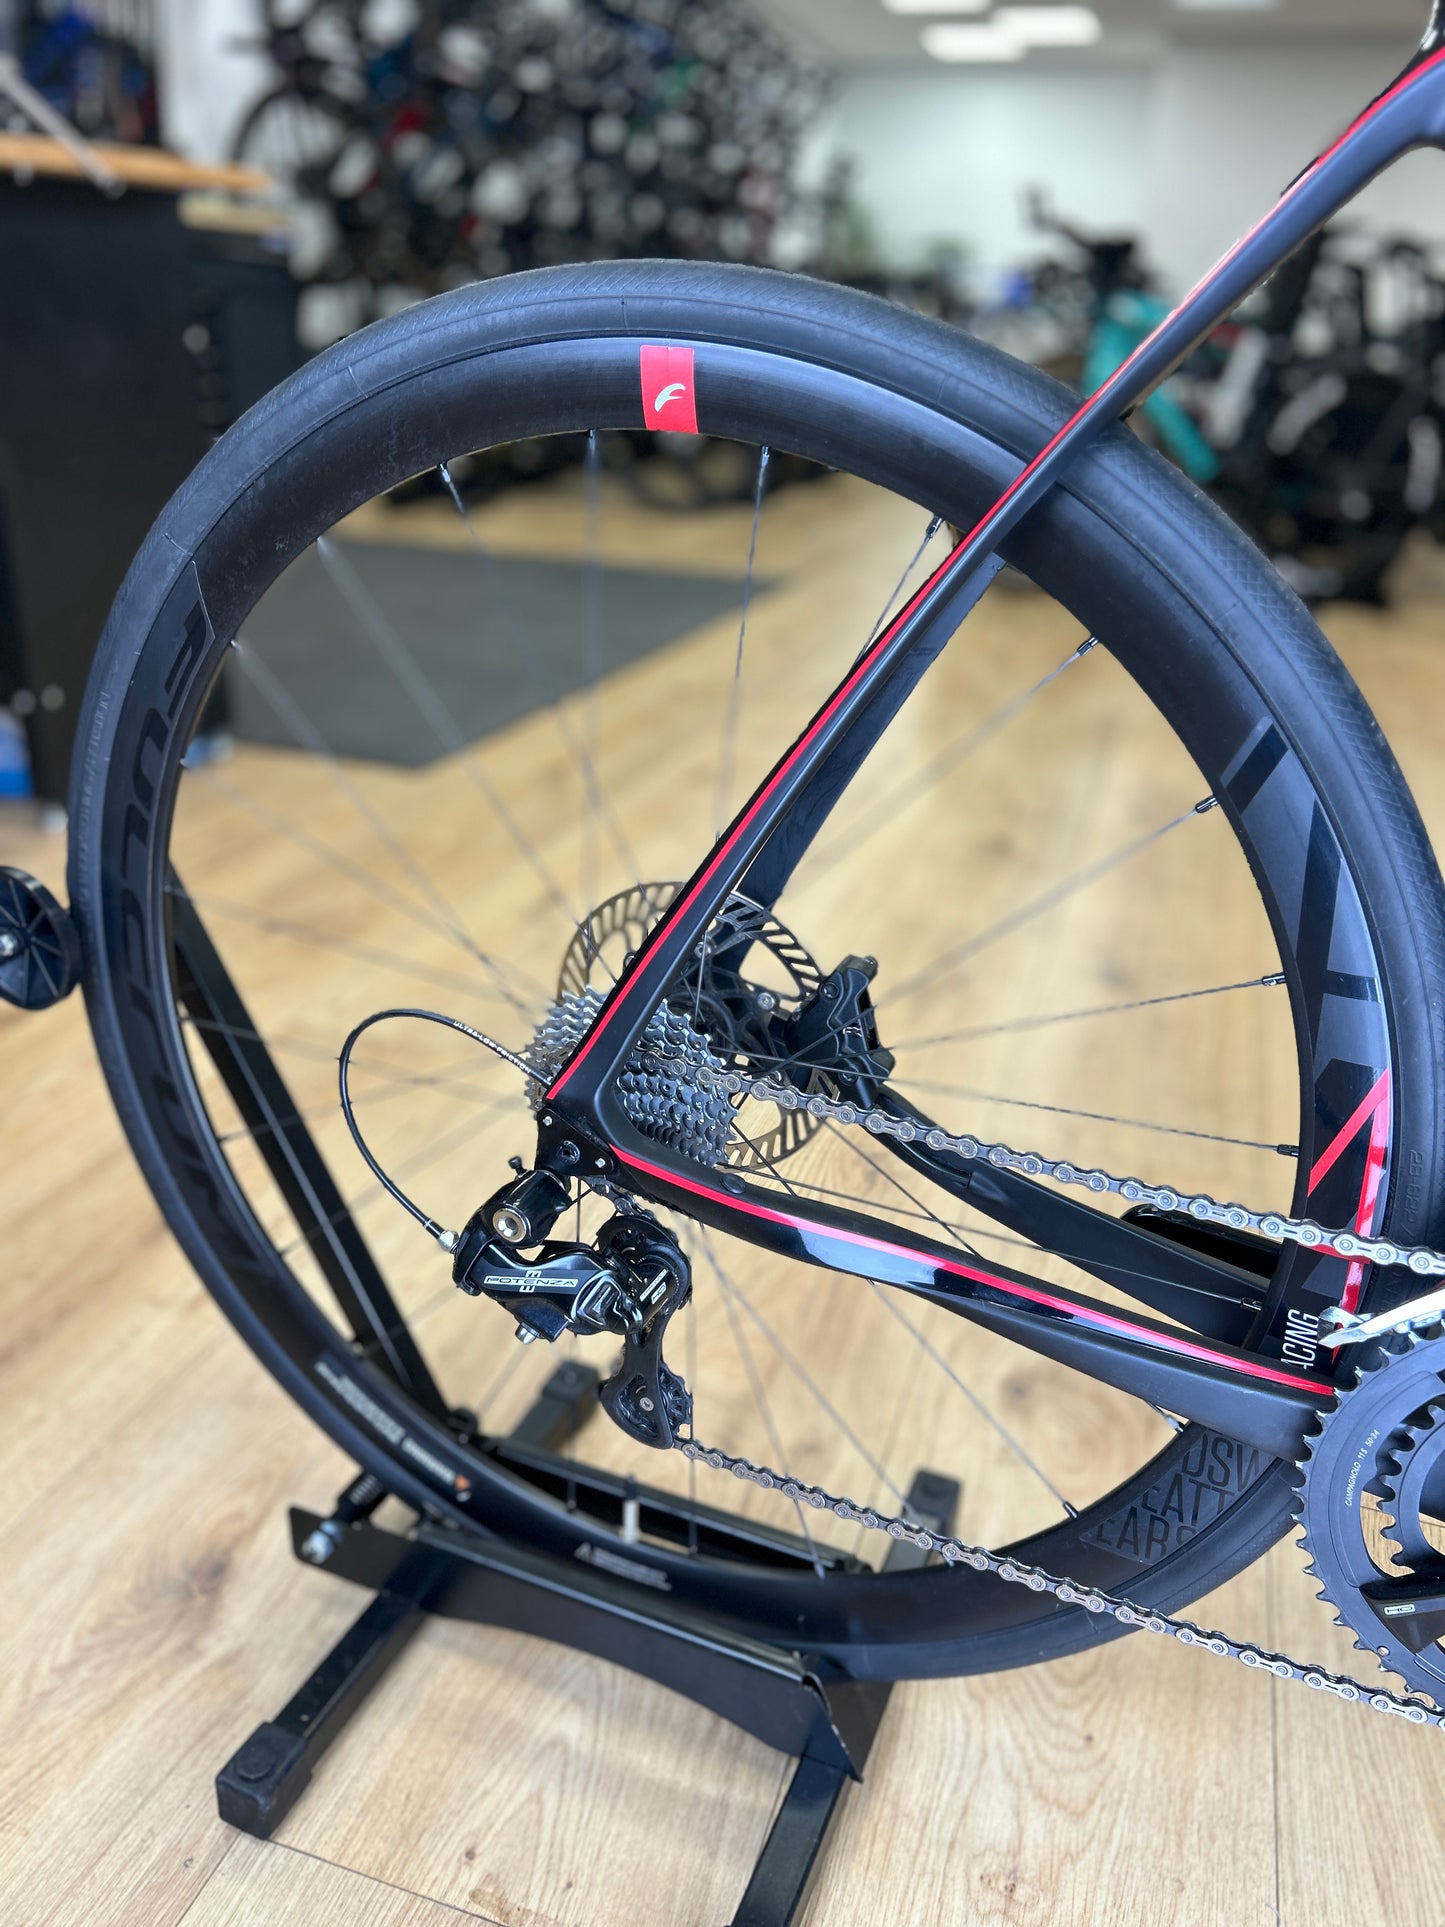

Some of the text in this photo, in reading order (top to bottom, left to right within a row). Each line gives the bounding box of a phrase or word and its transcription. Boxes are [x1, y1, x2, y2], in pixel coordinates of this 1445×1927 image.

[484, 1275, 579, 1288] POTENZA
[1280, 1309, 1319, 1370] ACING
[1344, 1461, 1361, 1507] CAMPAGNOLO
[1357, 1447, 1368, 1460] 11S
